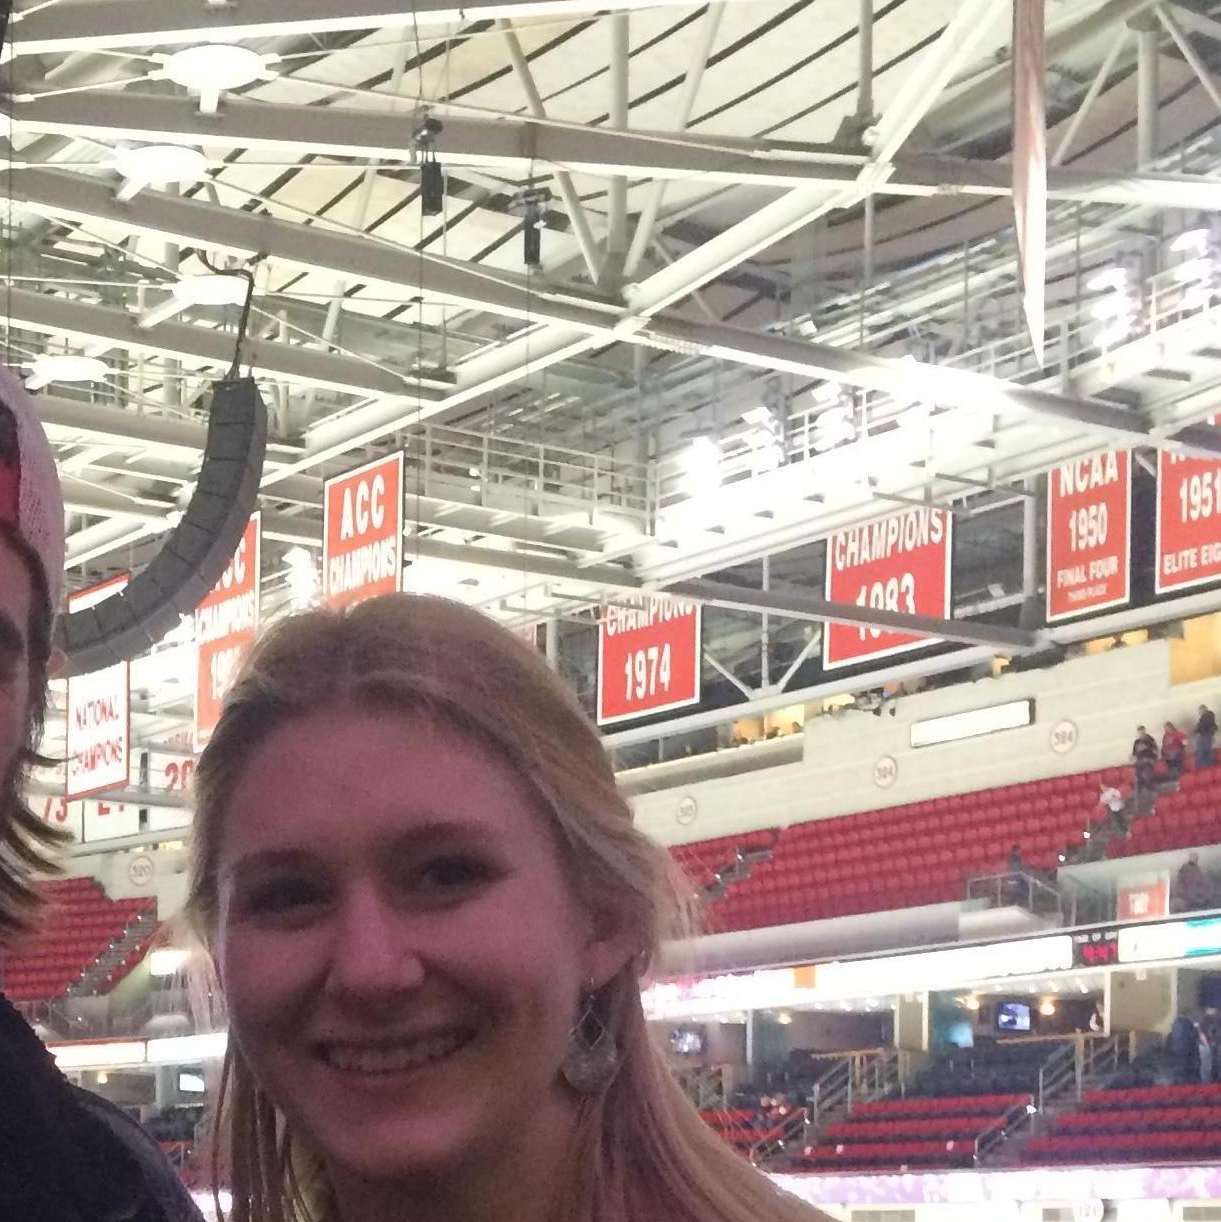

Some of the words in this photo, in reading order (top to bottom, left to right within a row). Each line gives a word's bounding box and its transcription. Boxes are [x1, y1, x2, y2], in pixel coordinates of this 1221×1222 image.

[1059, 446, 1119, 498] NCAA
[340, 473, 386, 541] ACC
[1068, 502, 1109, 552] 1950
[329, 534, 396, 596] CHAMPIONS
[834, 507, 944, 572] CHAMPIONS
[1162, 547, 1198, 576] ELITE
[1057, 564, 1088, 589] FINAL
[1088, 555, 1120, 581] FOUR
[624, 642, 672, 701] 1974
